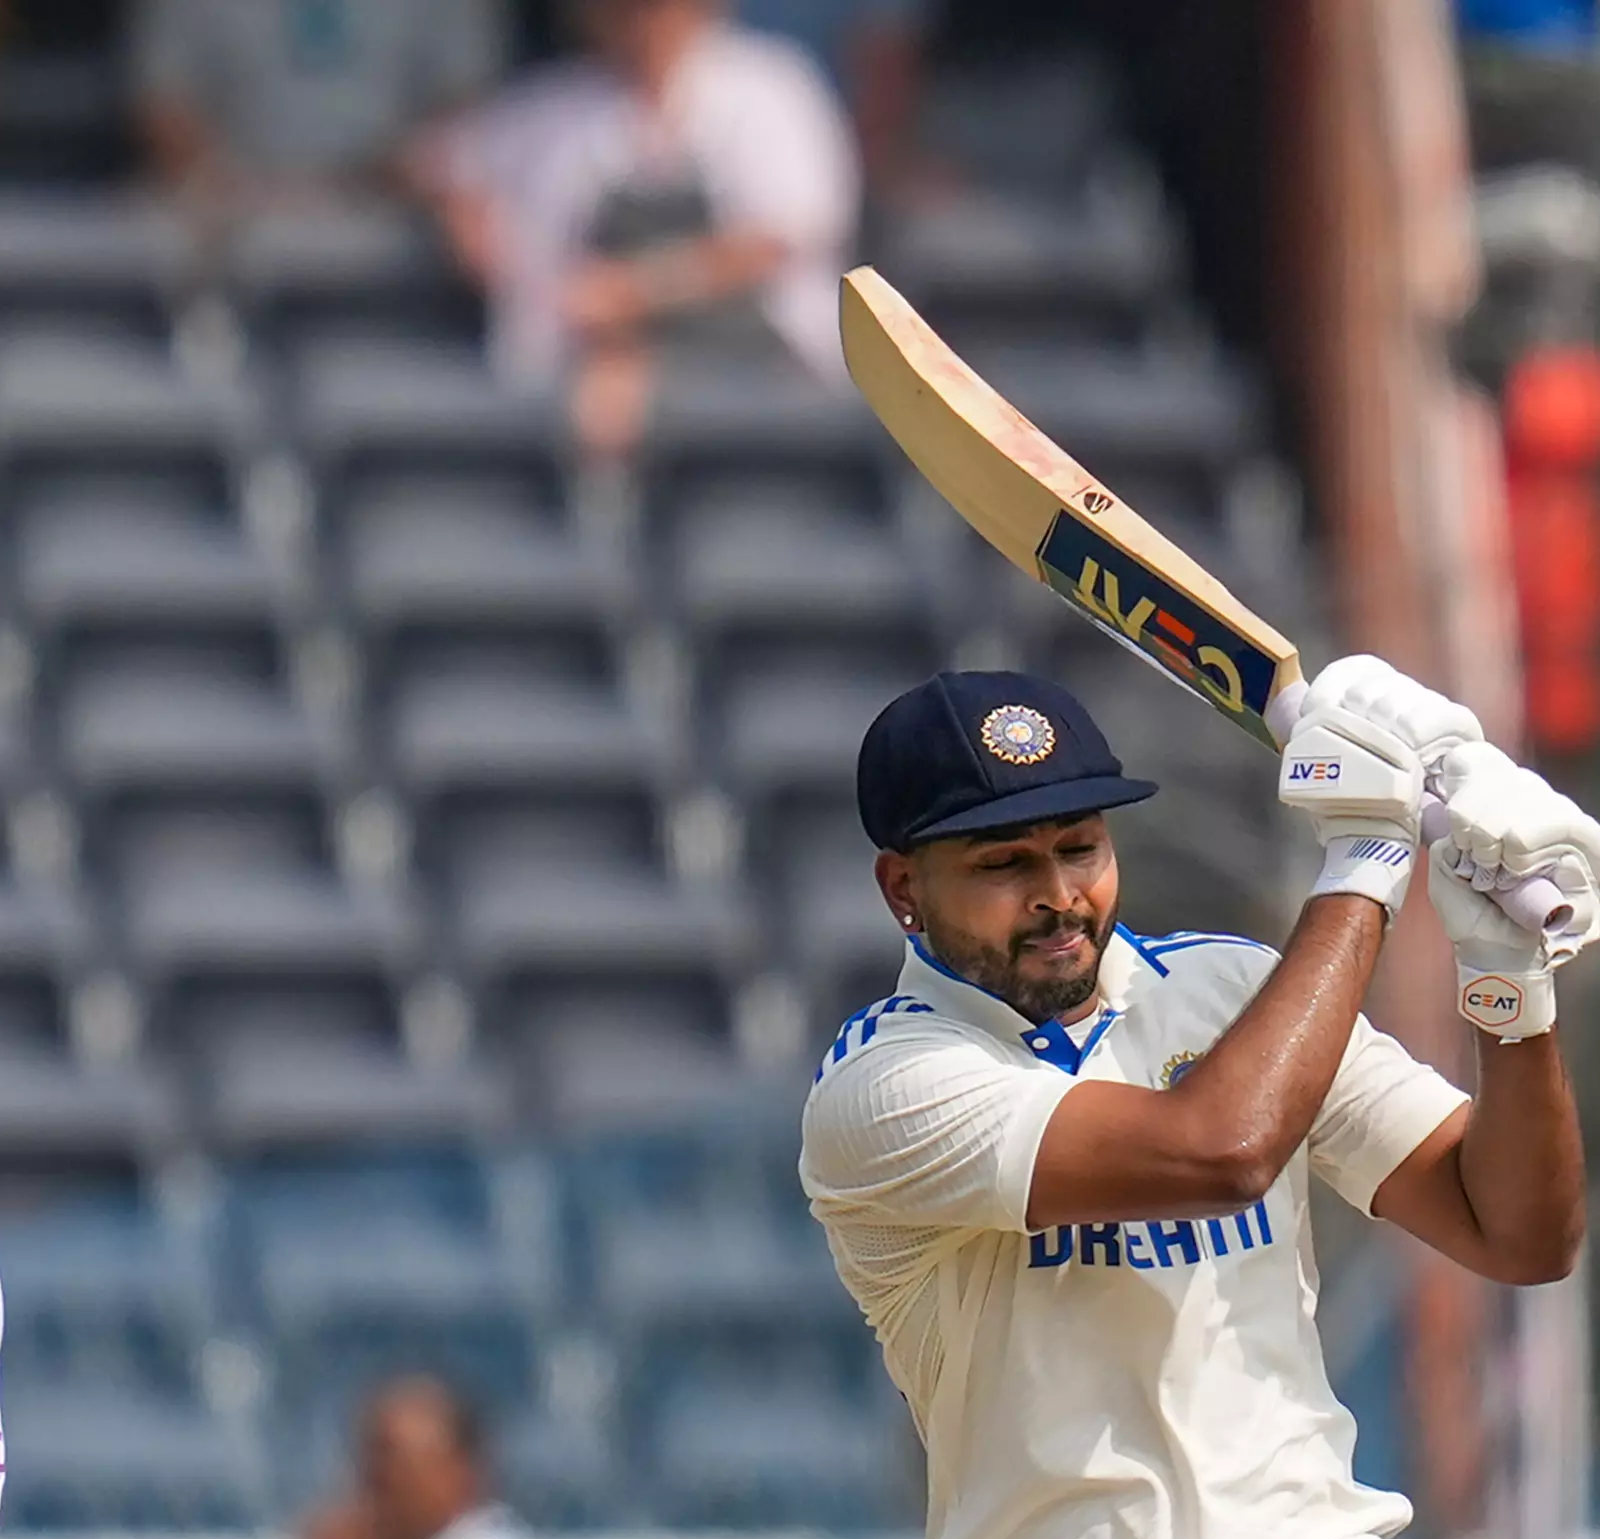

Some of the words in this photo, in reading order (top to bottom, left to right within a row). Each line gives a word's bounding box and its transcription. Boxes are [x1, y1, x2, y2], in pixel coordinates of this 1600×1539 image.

[1072, 556, 1243, 713] CEAT
[1288, 763, 1341, 780] CEAT
[1467, 993, 1517, 1010] CEAT
